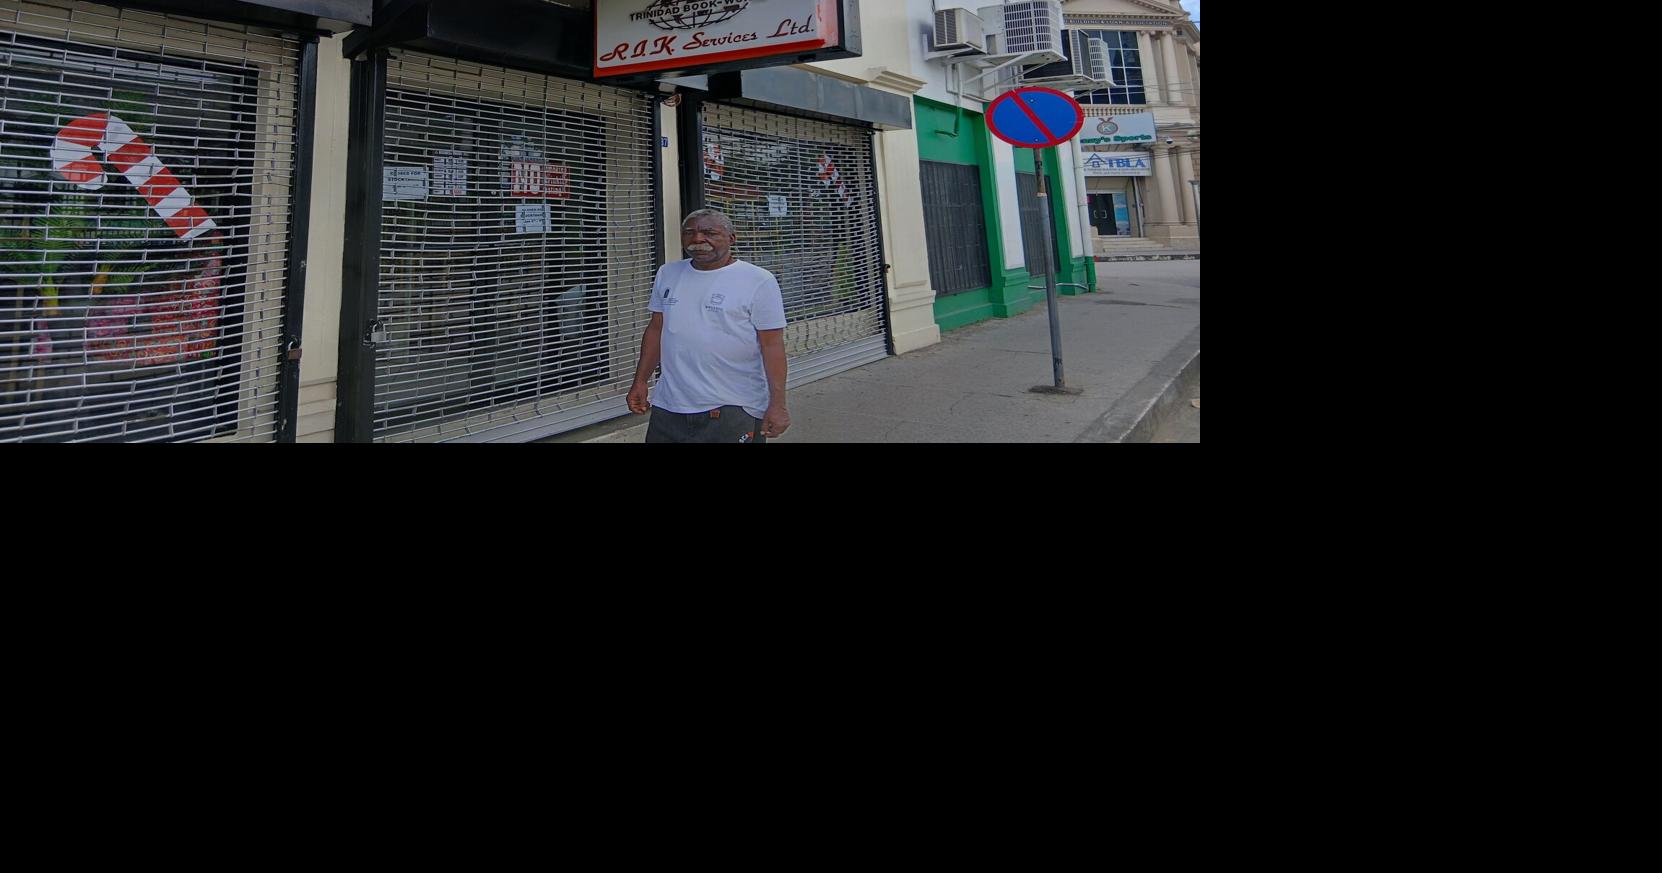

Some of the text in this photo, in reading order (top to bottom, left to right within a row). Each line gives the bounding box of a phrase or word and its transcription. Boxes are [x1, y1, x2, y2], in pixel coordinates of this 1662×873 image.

[629, 0, 748, 21] TRINIDAD BOOK-W
[682, 32, 758, 50] Services
[767, 14, 815, 38] Ltd.
